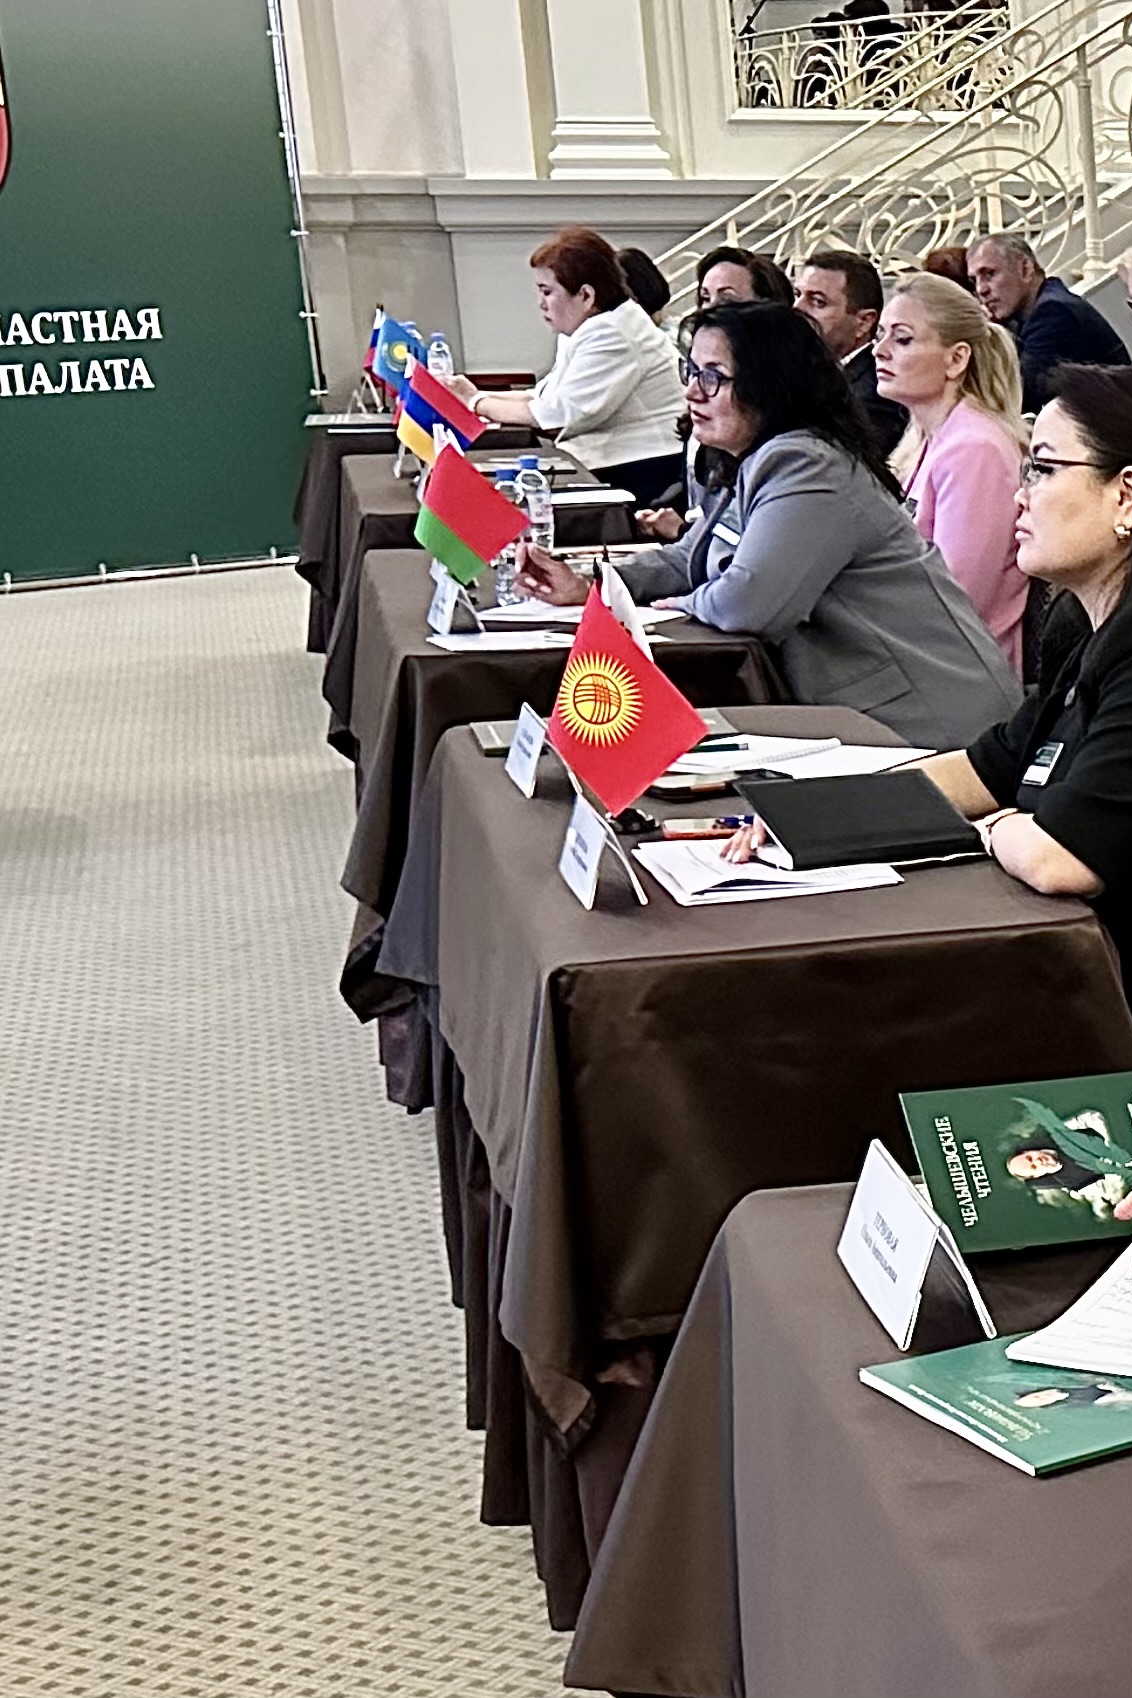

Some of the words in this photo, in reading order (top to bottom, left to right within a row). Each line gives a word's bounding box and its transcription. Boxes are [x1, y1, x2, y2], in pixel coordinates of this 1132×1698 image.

[0, 308, 163, 346] АСТНАЯ
[0, 357, 155, 397] ПАЛАТА
[934, 1116, 979, 1227] ЧЕЛЫШЕВСКИЕ
[962, 1141, 992, 1199] ЧТЕНИЯ
